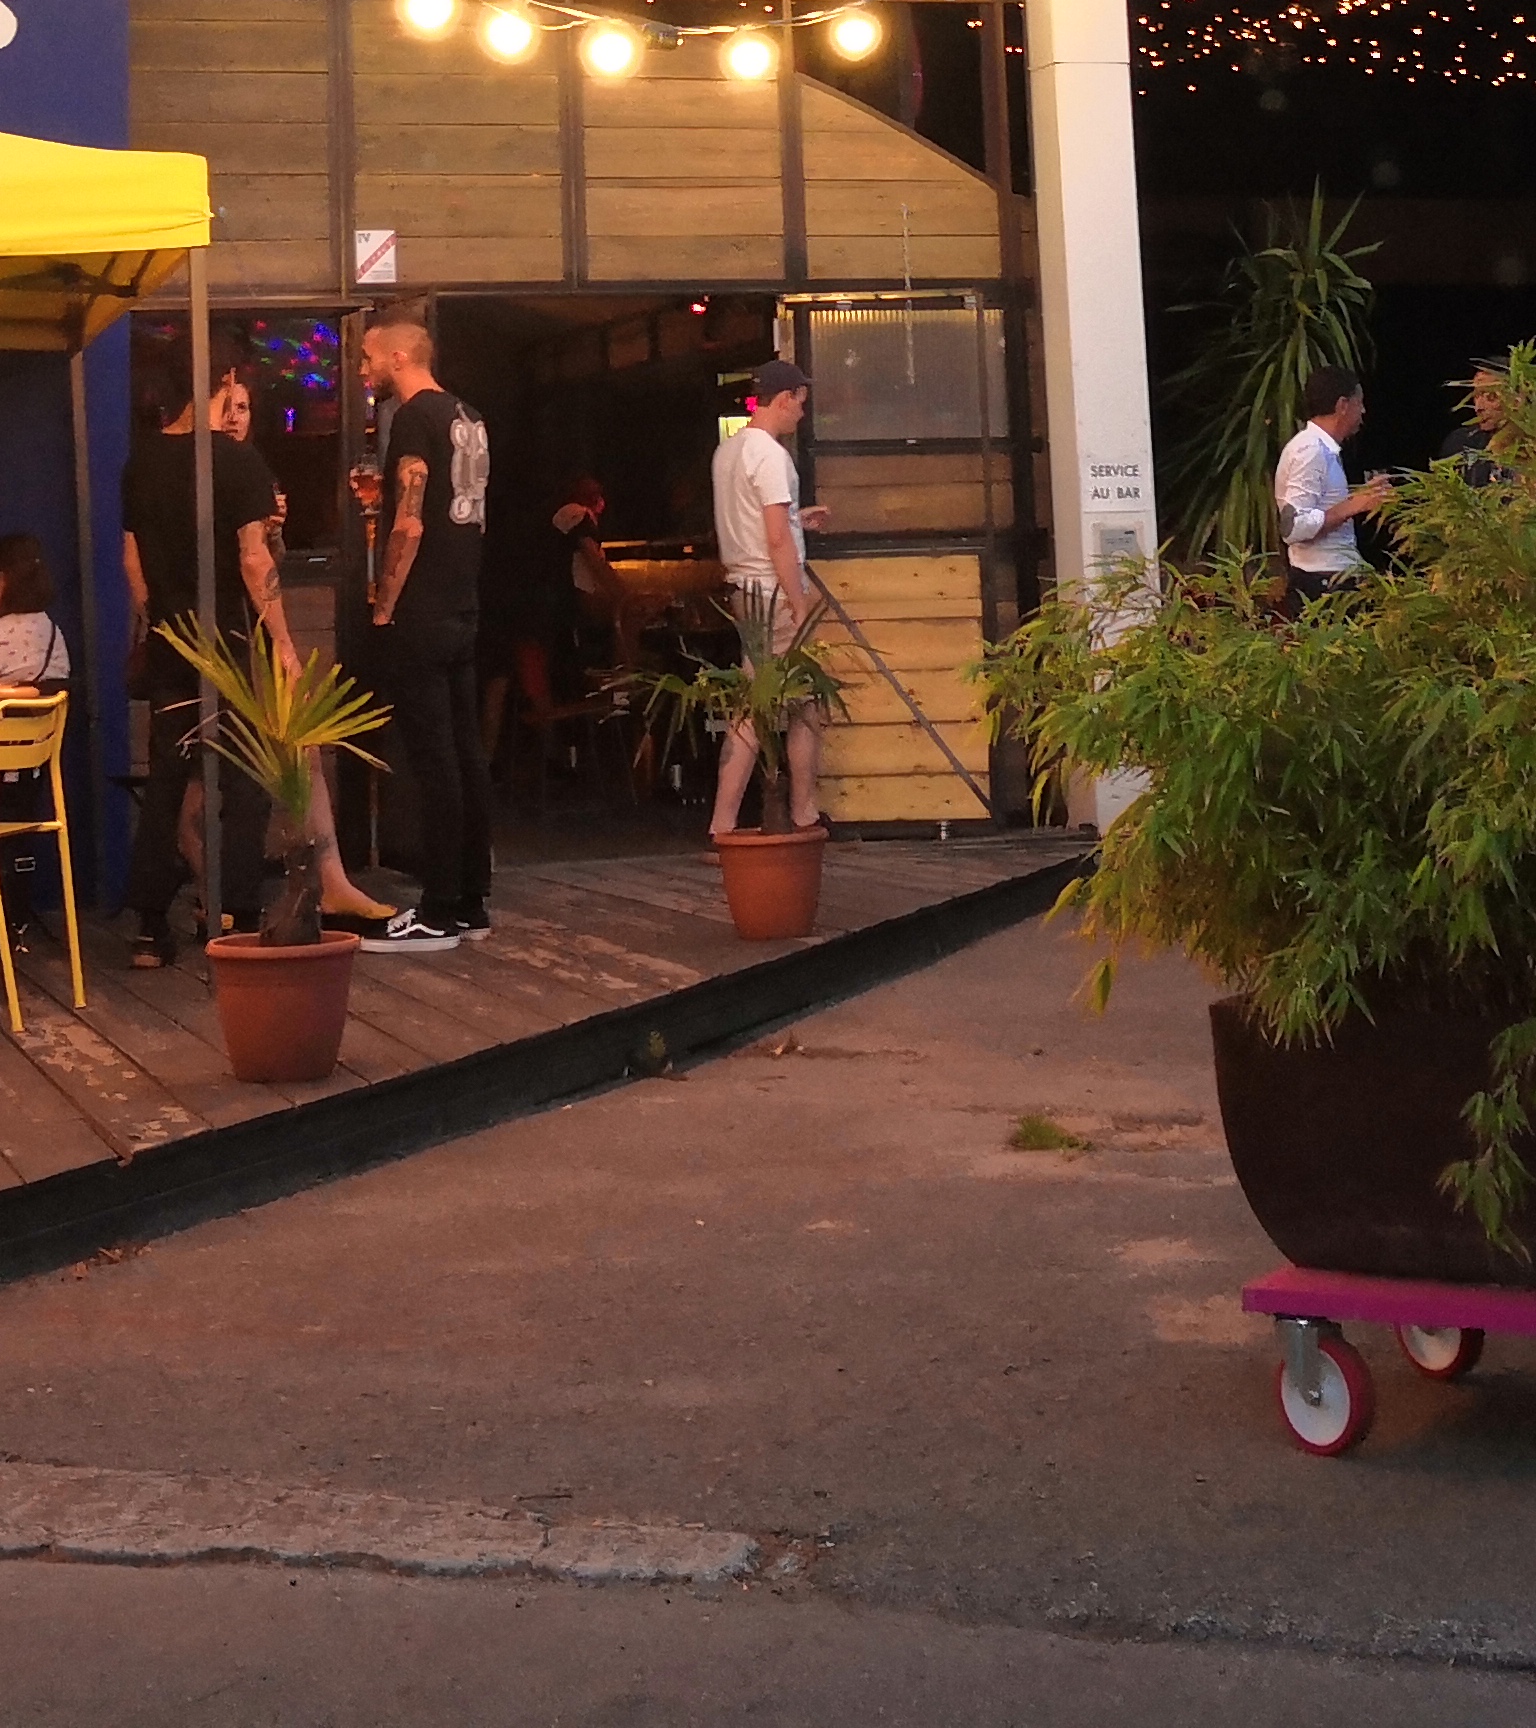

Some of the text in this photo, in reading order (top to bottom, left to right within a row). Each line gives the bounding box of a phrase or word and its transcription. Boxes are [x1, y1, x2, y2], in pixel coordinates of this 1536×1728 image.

[1090, 464, 1140, 478] SERVICE
[1091, 487, 1141, 500] AU BAR
